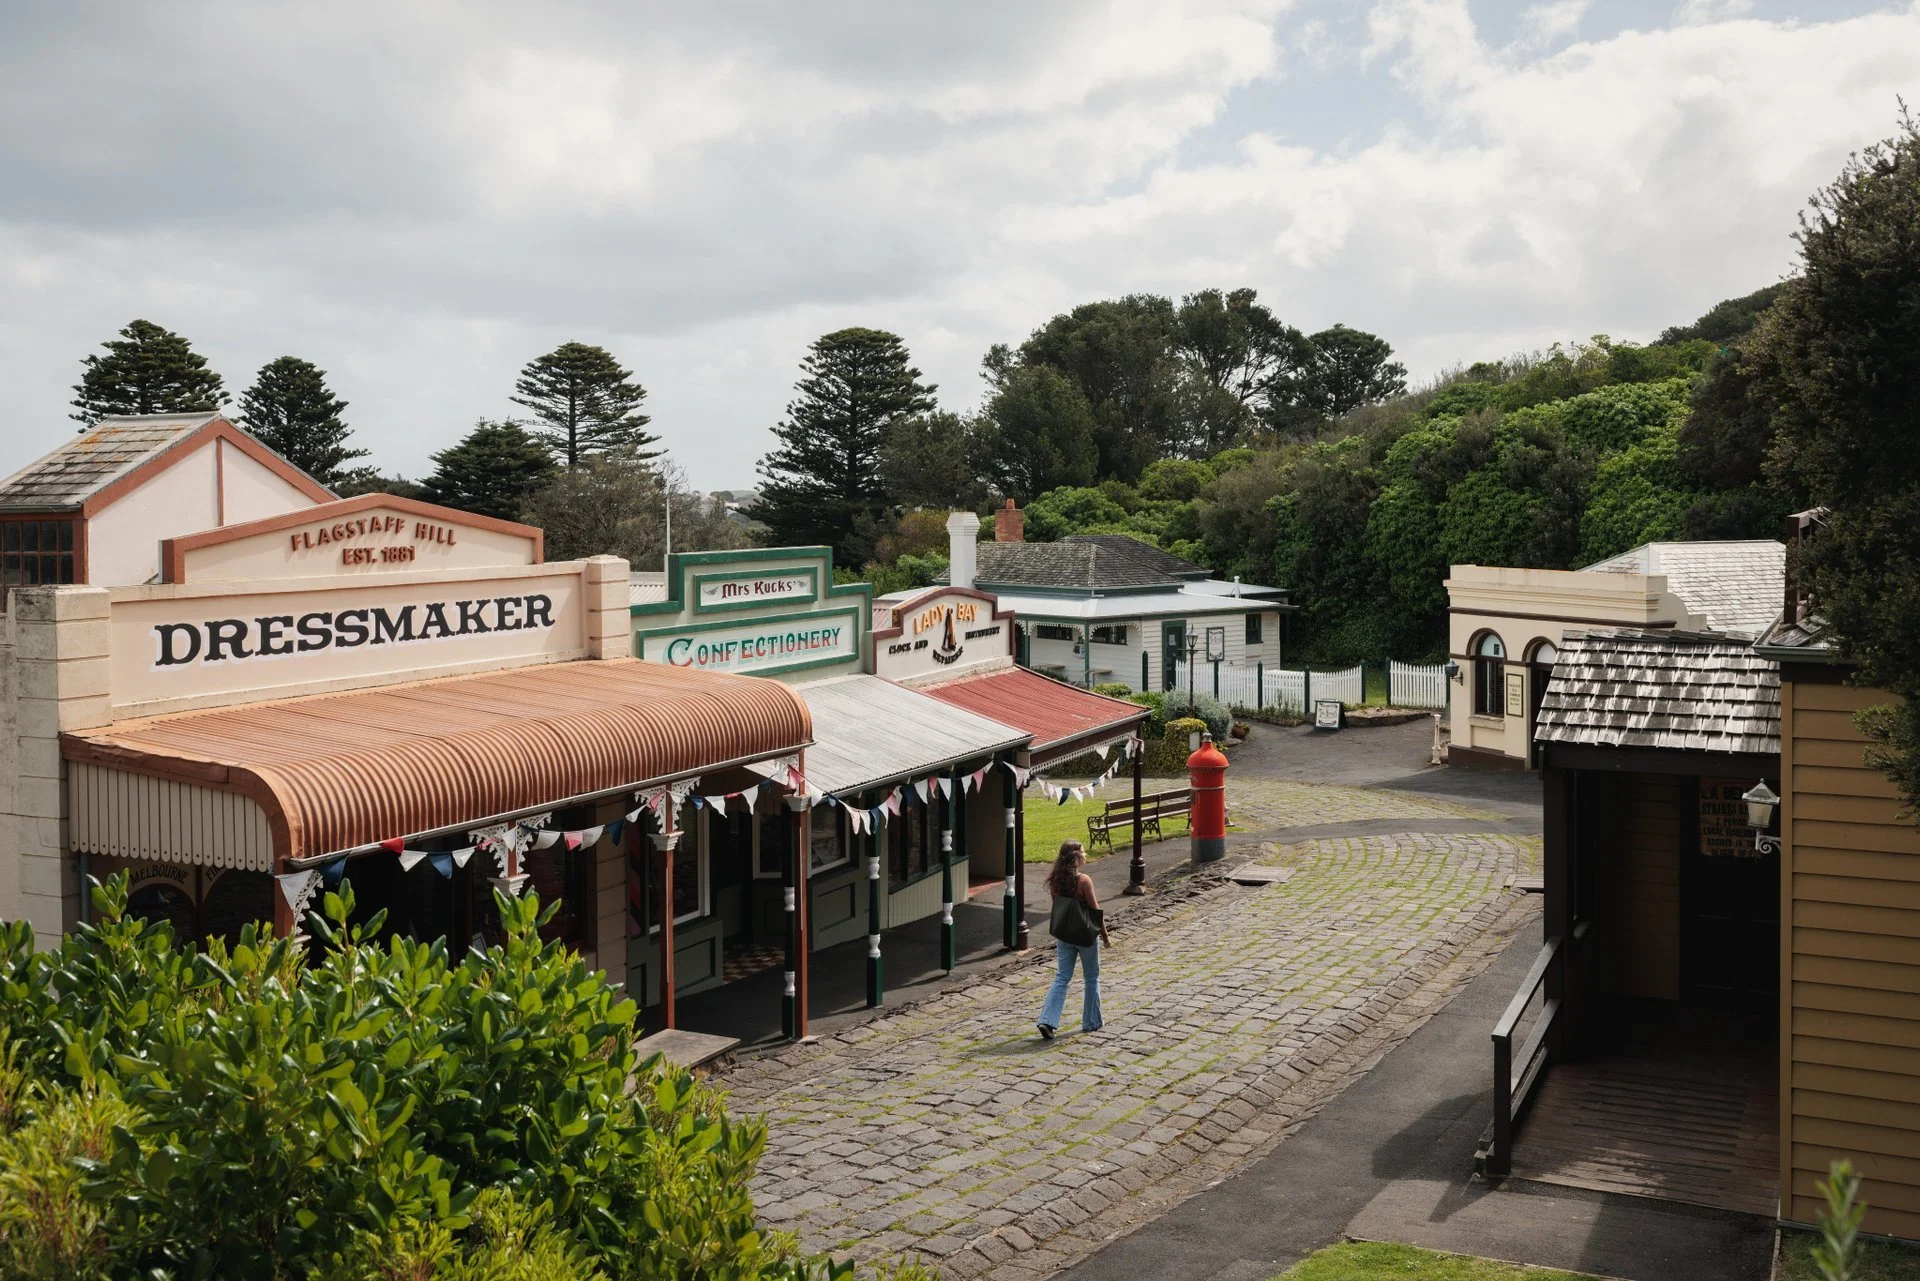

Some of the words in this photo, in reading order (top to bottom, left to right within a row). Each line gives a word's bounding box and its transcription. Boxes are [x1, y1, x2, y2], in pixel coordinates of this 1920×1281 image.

[291, 516, 406, 551] FLAGSTAFF
[415, 522, 456, 546] HILL
[343, 547, 378, 565] EST.
[381, 545, 416, 563] 1881
[721, 583, 750, 598] Mrs
[754, 579, 797, 595] Kucks'
[154, 593, 556, 667] DRESSMAKER
[913, 603, 946, 635] LADY
[956, 602, 978, 622] BAY
[889, 642, 911, 655] CLOCK
[914, 639, 929, 650] AND
[129, 864, 188, 887] MELBOURNE
